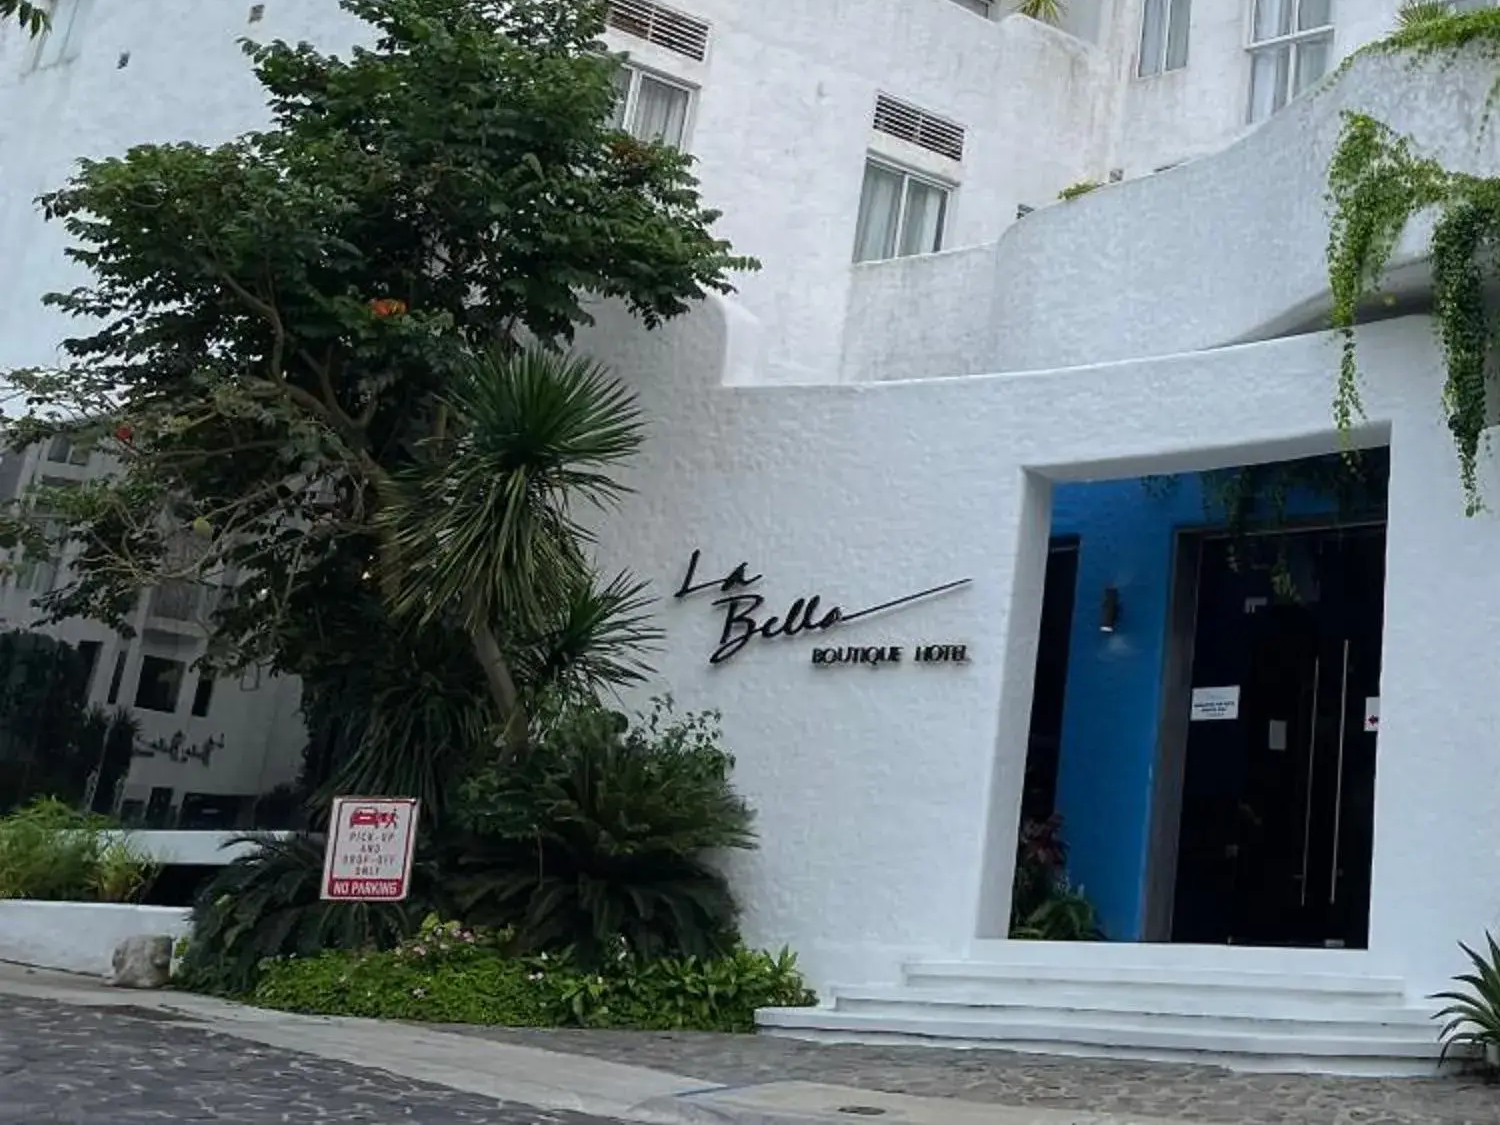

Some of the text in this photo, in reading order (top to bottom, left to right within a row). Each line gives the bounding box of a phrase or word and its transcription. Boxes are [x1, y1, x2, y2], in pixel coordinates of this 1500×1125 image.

[674, 549, 762, 597] La
[811, 644, 968, 664] BOUTIQUE HOTEL
[361, 844, 381, 853] AND
[333, 881, 398, 895] NO PARKING
